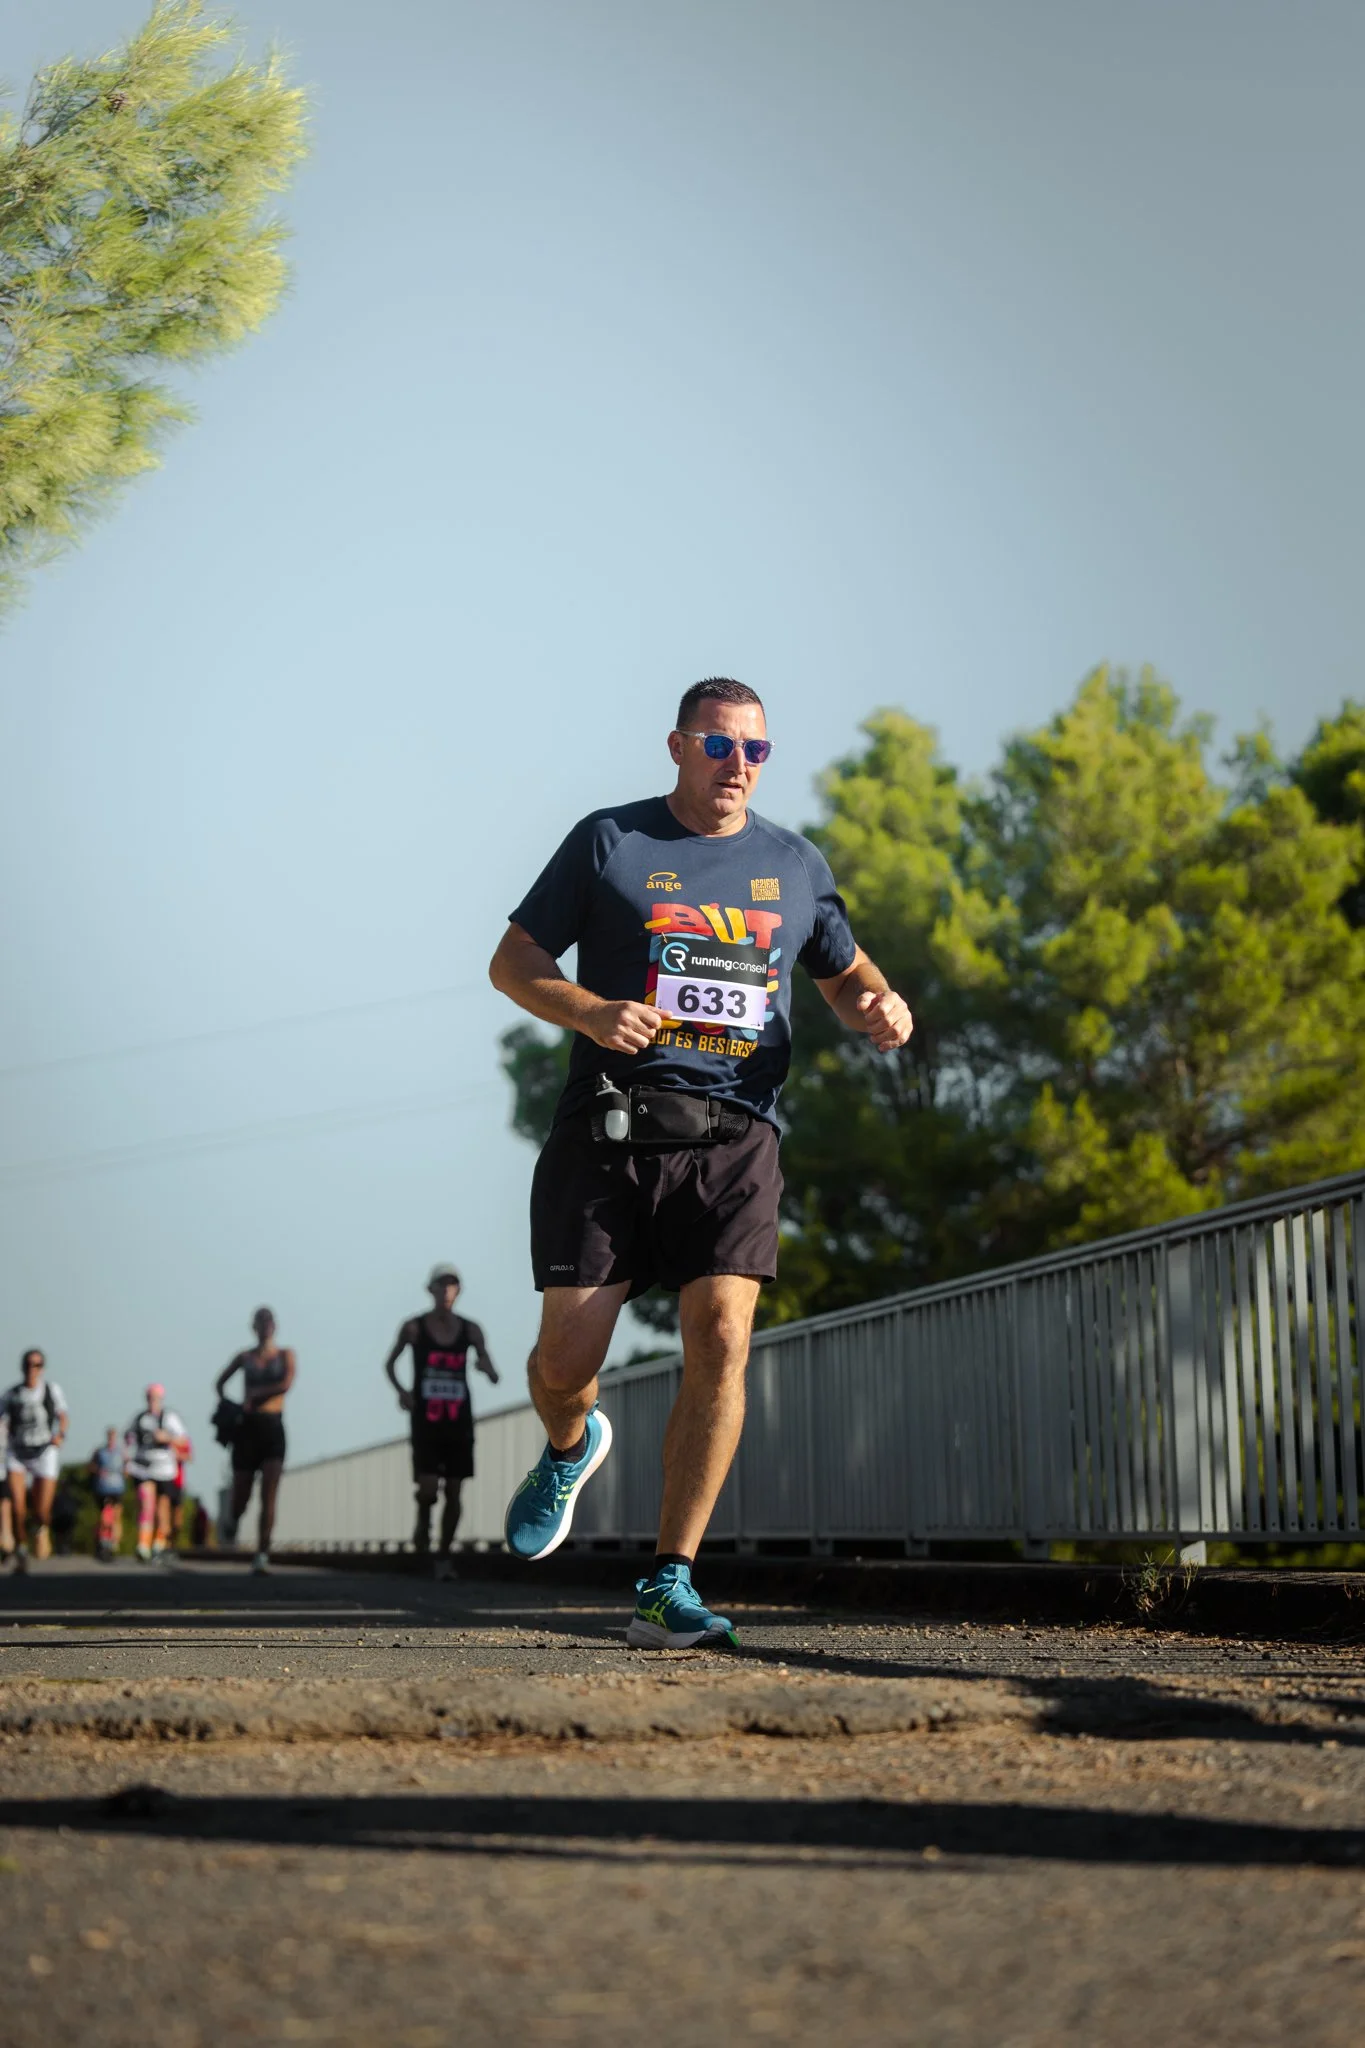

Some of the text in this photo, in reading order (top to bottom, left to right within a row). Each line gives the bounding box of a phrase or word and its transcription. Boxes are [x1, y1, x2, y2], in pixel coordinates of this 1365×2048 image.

[646, 880, 682, 892] ange
[652, 903, 782, 949] BUT
[677, 984, 747, 1019] 633
[675, 1031, 694, 1050] ES
